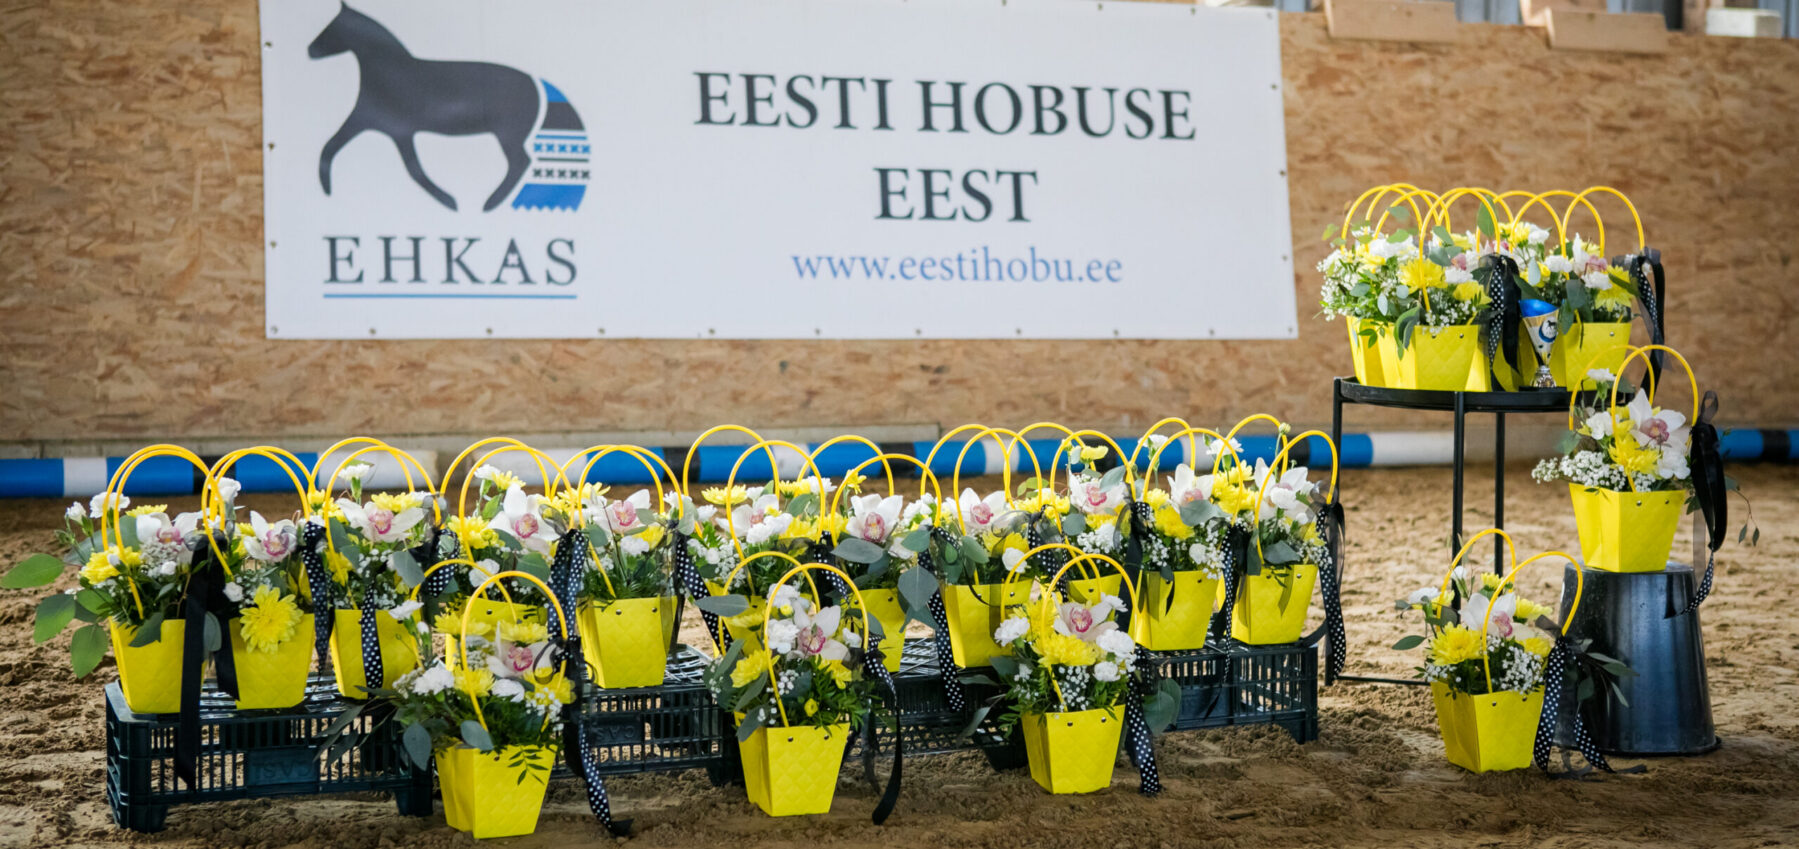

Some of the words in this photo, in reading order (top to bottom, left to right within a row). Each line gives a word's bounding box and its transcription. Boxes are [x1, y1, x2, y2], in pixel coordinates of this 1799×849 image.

[693, 71, 894, 131] EESTI
[915, 79, 1197, 141] HOBUSE
[873, 166, 1039, 223] EEST
[323, 235, 578, 285] EHKAS
[791, 245, 1123, 284] www.eestihobu.ee
